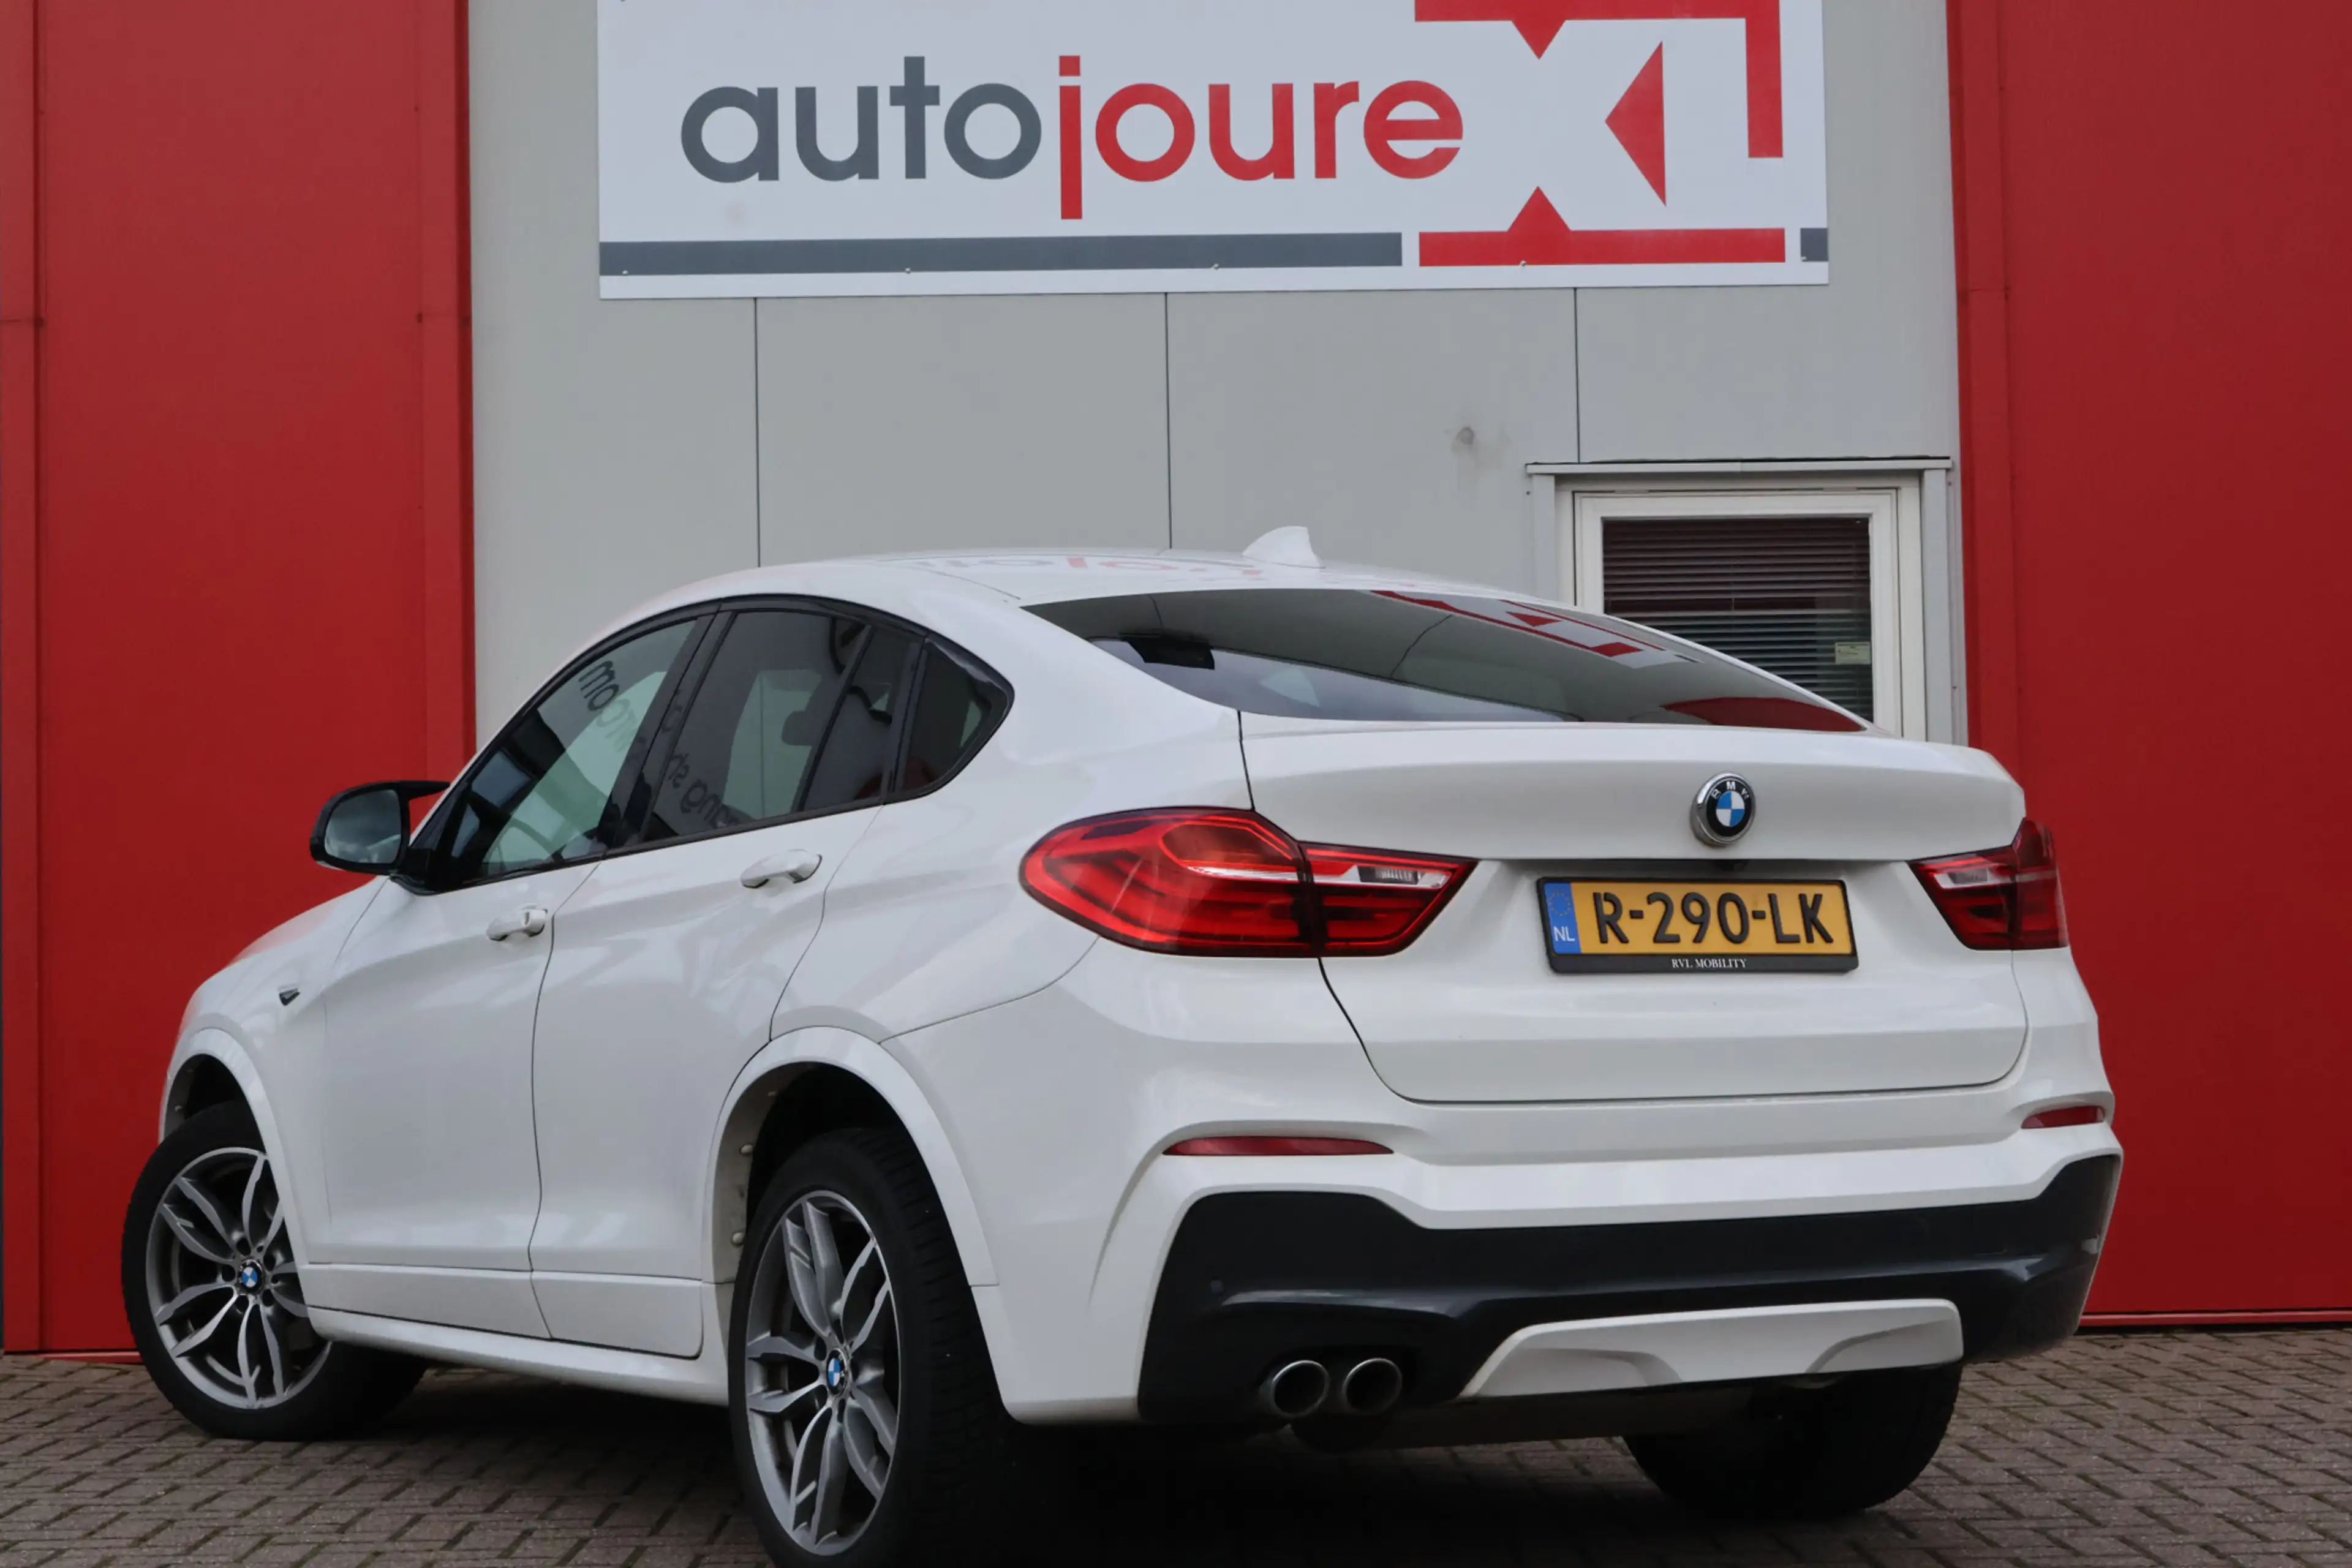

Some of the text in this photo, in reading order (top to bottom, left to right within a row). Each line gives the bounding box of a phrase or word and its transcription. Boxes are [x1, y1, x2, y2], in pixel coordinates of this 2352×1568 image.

[680, 55, 1463, 220] autojoure
[1711, 781, 1750, 800] BMW
[1593, 892, 1833, 944] R-290-LK
[1554, 925, 1575, 941] NL
[1672, 958, 1746, 968] RVL MOBILITY
